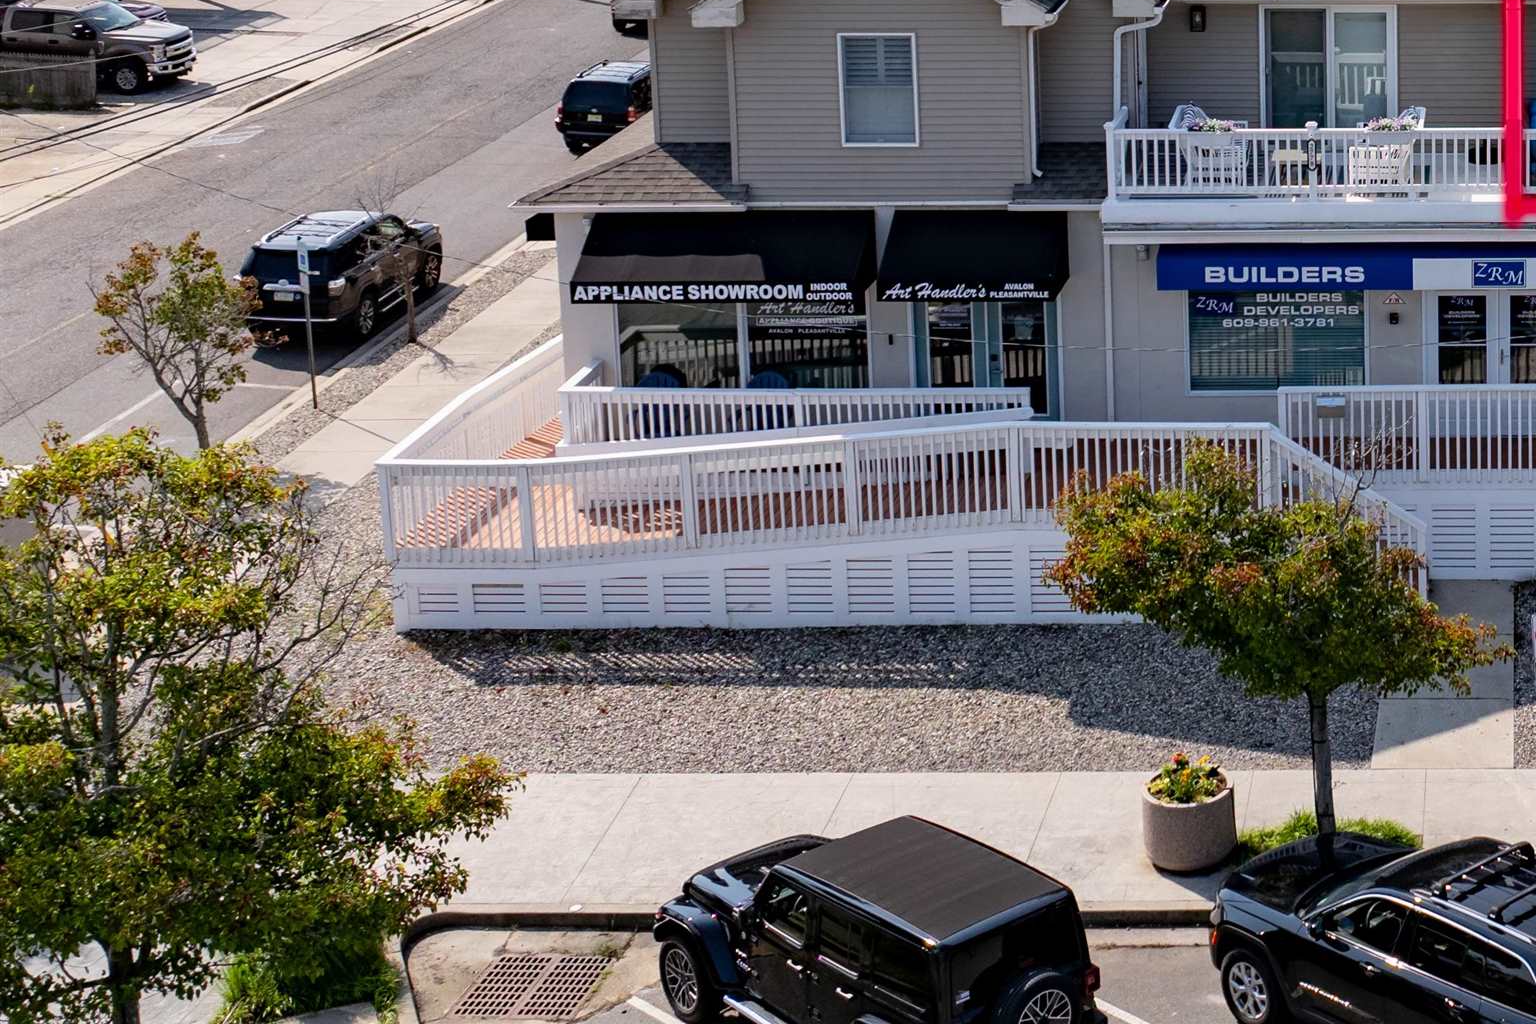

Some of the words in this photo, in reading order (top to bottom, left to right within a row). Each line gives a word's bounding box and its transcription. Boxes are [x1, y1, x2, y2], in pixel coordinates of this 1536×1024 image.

[1203, 265, 1366, 284] BUILDERS
[1474, 262, 1524, 285] ZRM
[573, 284, 685, 301] APPLIANCE
[687, 283, 804, 301] SHOWROOM
[809, 282, 848, 291] INDOOR
[881, 281, 913, 300] Art
[914, 281, 987, 299] Handler's
[1003, 282, 1035, 291] AVALON
[805, 291, 853, 301] OUTDOOR
[989, 290, 1050, 299] PLEASANTVILLE
[1255, 292, 1343, 303] BUILDERS
[756, 301, 786, 315] Art
[1195, 295, 1234, 314] ZRM
[1242, 305, 1360, 316] DEVELOPERS
[1221, 317, 1335, 328] 609-961-3781
